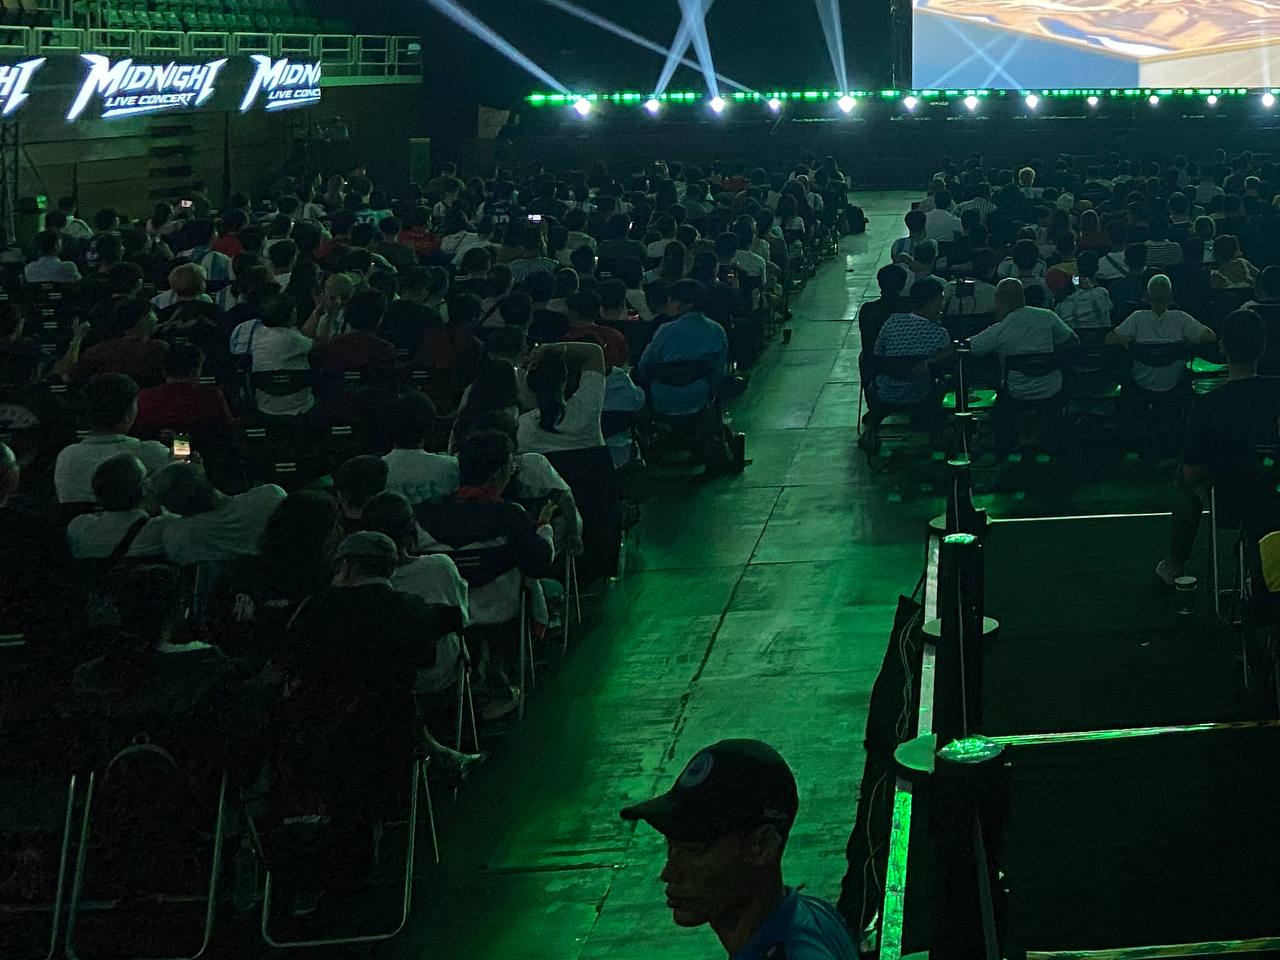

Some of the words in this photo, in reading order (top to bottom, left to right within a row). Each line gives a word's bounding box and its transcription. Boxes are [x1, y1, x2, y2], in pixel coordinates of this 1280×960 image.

[66, 53, 229, 119] MIDNIGHT
[105, 96, 136, 106] LIVE
[138, 93, 196, 106] CONCERT
[267, 90, 293, 99] LIVE
